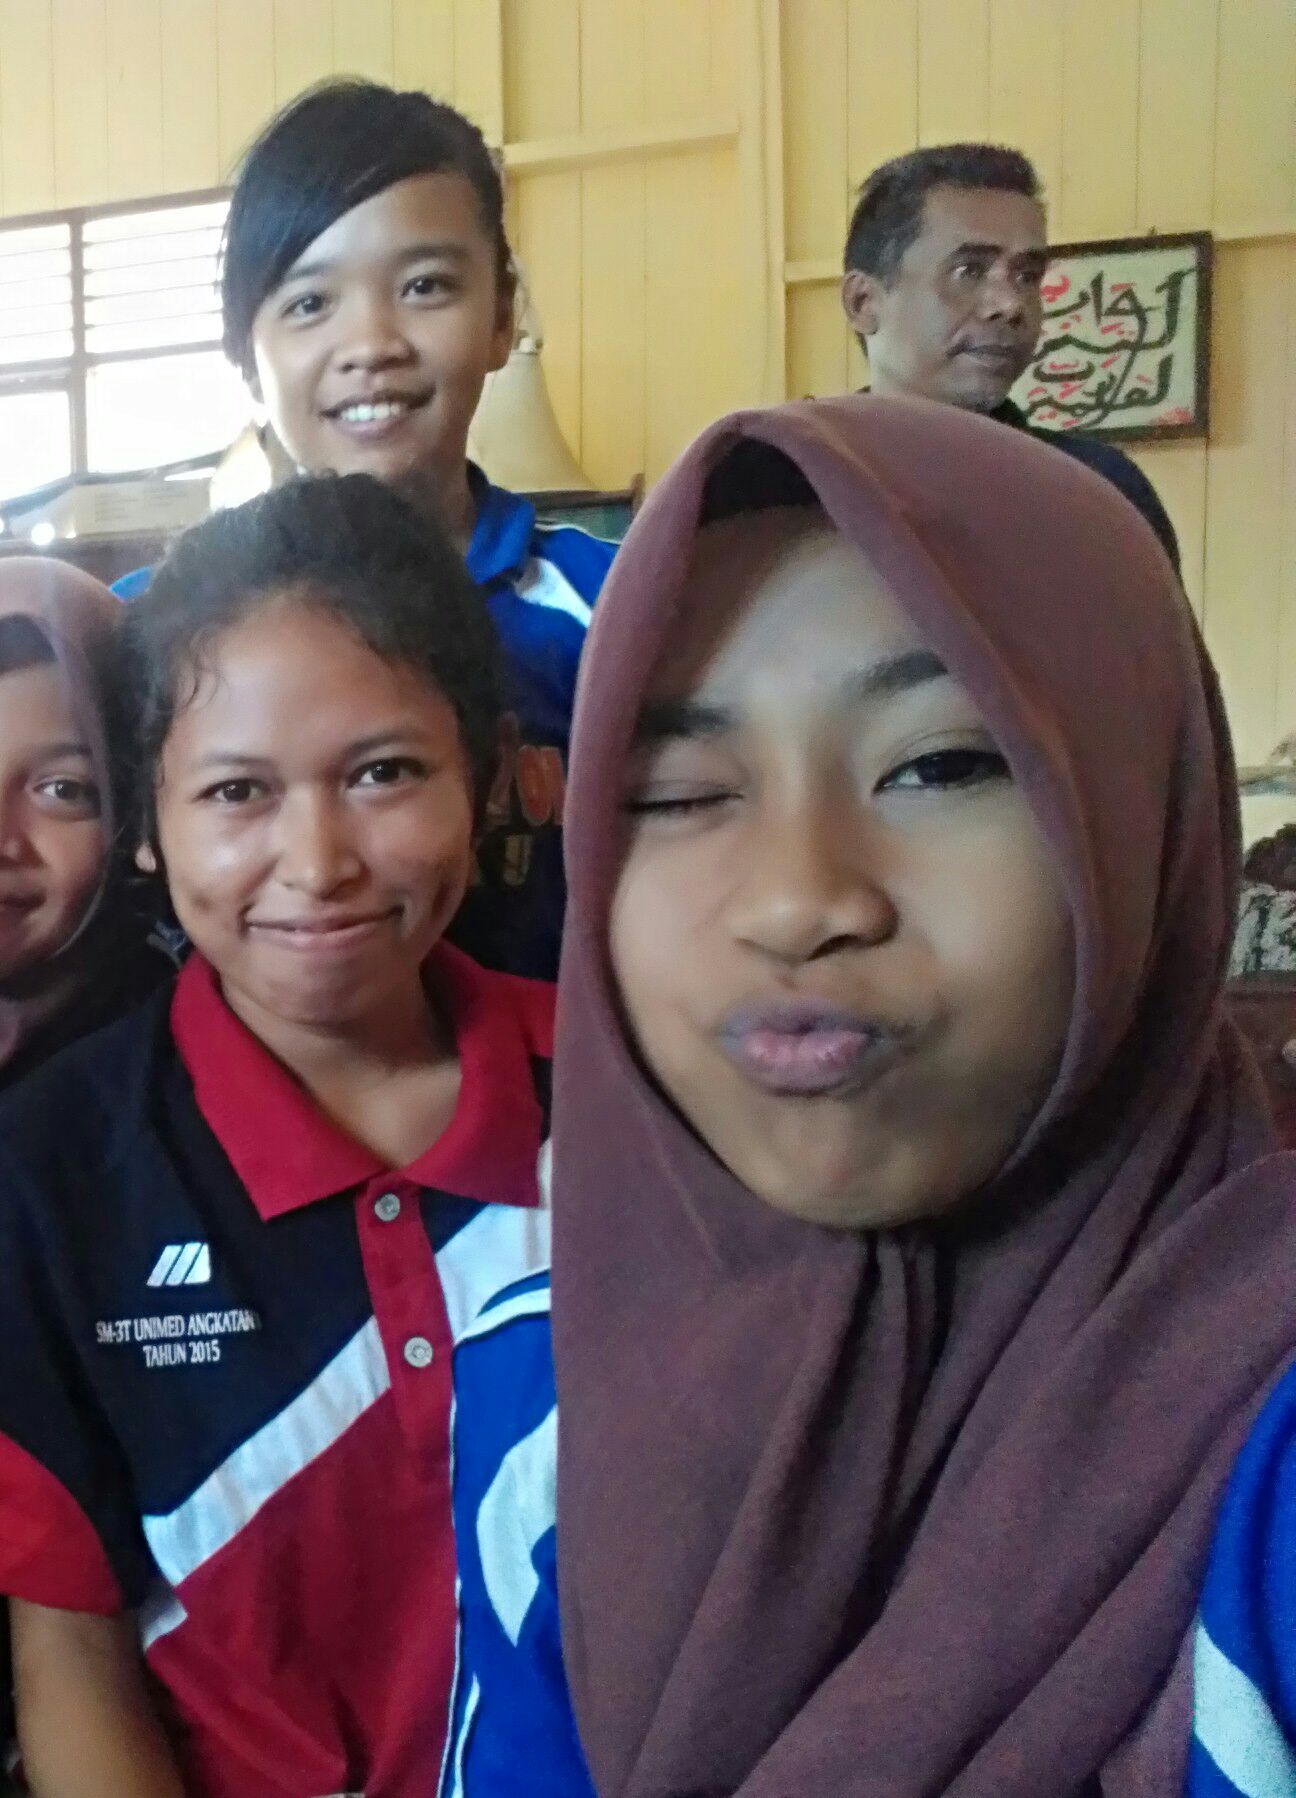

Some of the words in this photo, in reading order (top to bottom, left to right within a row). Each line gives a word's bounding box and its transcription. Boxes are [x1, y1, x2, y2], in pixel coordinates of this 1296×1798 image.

[133, 1314, 185, 1341] UNIMED
[187, 1309, 257, 1336] ANGKATAN
[142, 1343, 187, 1368] TAHUN
[188, 1339, 221, 1364] 2015
